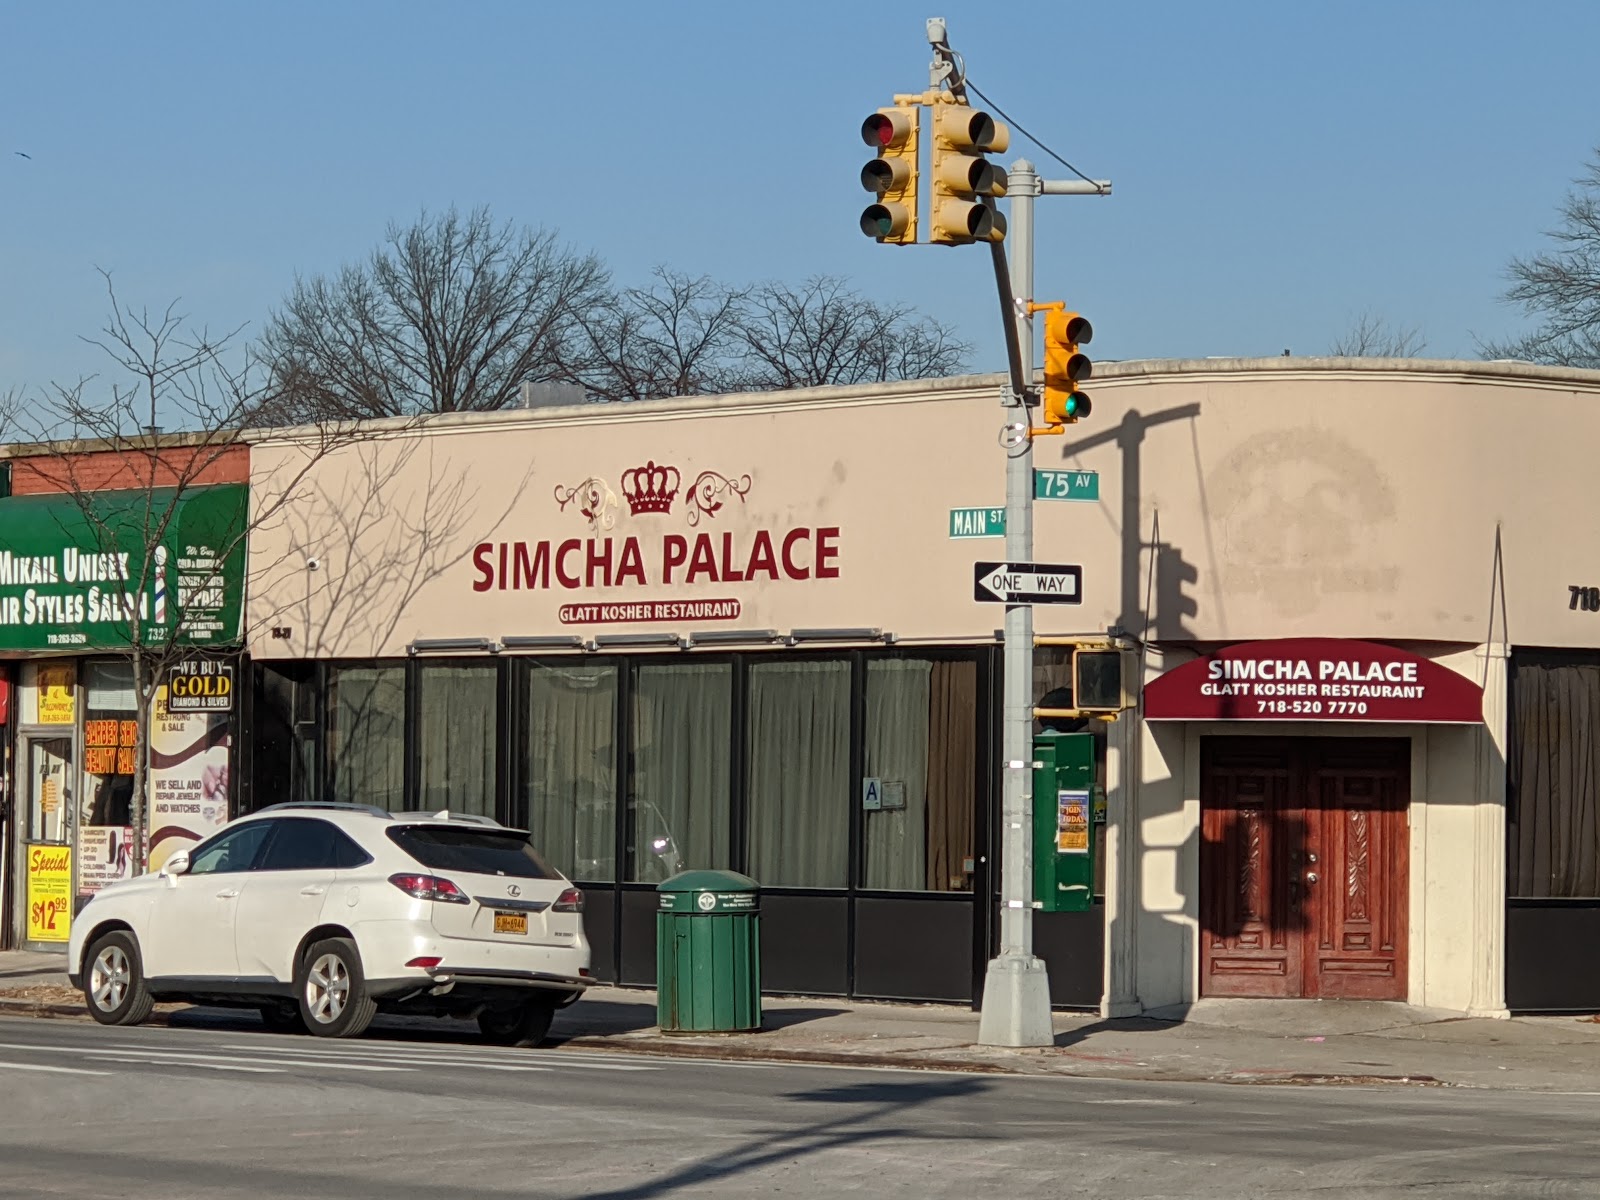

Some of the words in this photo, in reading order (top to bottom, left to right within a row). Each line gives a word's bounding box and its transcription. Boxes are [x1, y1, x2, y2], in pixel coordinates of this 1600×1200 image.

[1041, 473, 1070, 497] 75
[1075, 475, 1091, 487] AV
[953, 511, 986, 535] MAIN
[990, 510, 1003, 523] ST
[63, 548, 129, 582] UNISEX
[473, 536, 648, 592] SIMCHA
[661, 527, 841, 585] PALACE
[992, 574, 1022, 591] ONE
[1036, 576, 1066, 592] WAY
[24, 588, 84, 625] STYLES
[560, 607, 599, 622] GLATT
[602, 604, 651, 620] KOSHER
[654, 602, 739, 619] RESTAURANT
[180, 661, 198, 675] WE
[201, 661, 224, 675] BUY
[1208, 660, 1312, 680] SIMCHA
[1319, 661, 1418, 682] PALACE
[172, 676, 230, 696] GOLD
[1200, 683, 1250, 696] GLATT
[1254, 684, 1317, 696] KOSHER
[1321, 685, 1425, 698] RESTAURANT
[173, 697, 200, 707] DIAMOND
[201, 697, 206, 706] &
[207, 697, 228, 707] SILVER
[1257, 701, 1322, 713] 718-520
[1328, 702, 1367, 714] 7770
[85, 720, 119, 746] BARBER
[120, 720, 138, 746] SHO
[168, 723, 185, 731] SALE
[85, 747, 117, 773] BEAUTY
[155, 781, 166, 789] WE
[168, 781, 185, 789] SELL
[187, 781, 202, 789] AND
[866, 781, 878, 800] A
[156, 792, 175, 800] REPAIR
[156, 804, 168, 812] AND
[170, 804, 200, 813] WATCHES
[31, 849, 70, 876] Special
